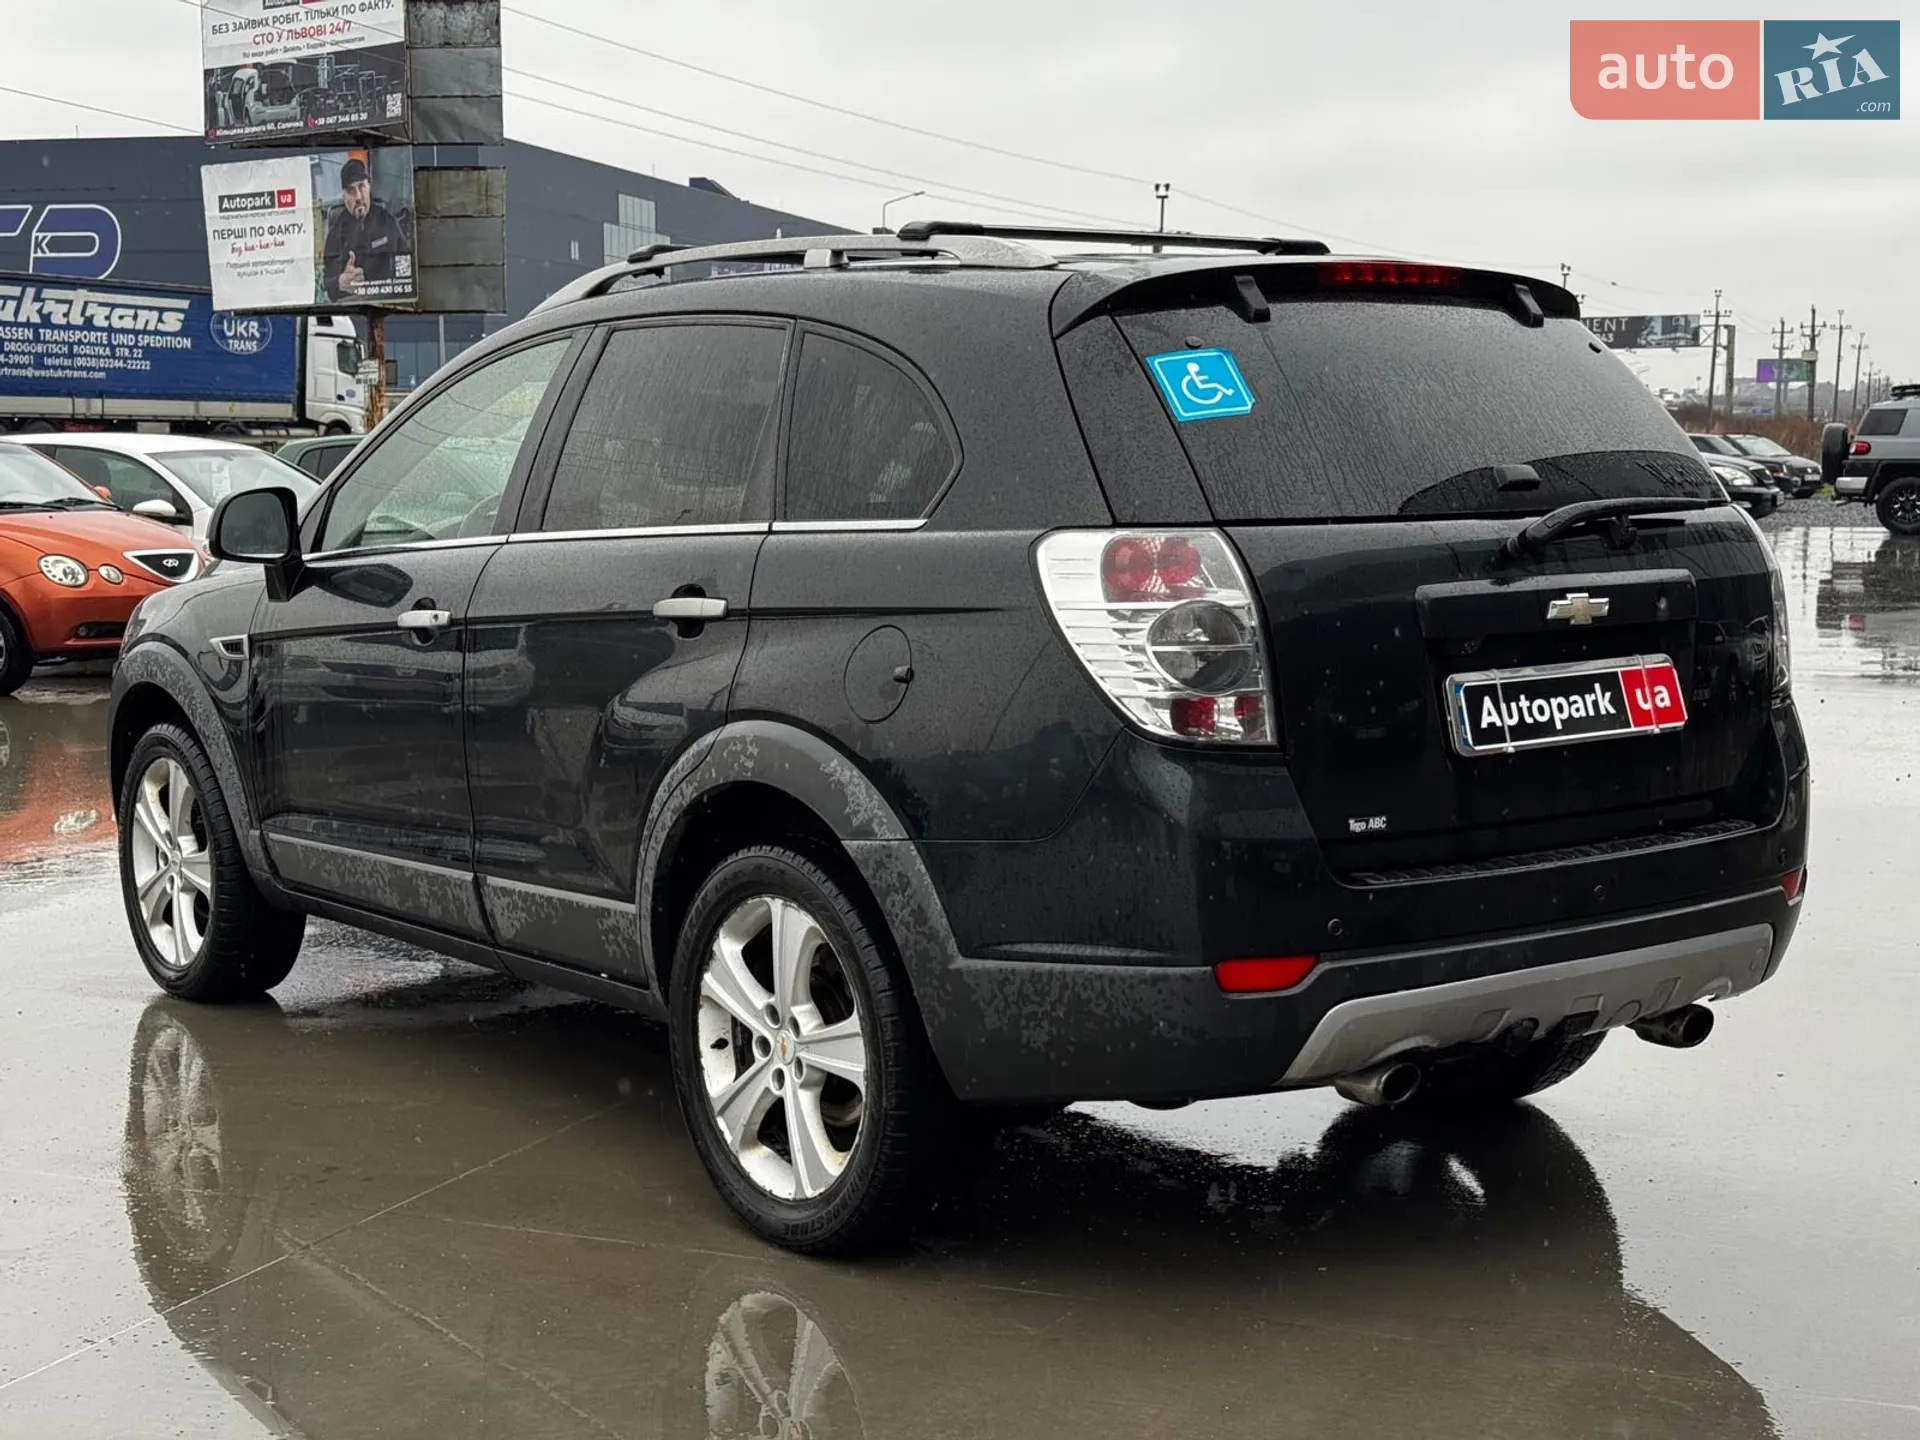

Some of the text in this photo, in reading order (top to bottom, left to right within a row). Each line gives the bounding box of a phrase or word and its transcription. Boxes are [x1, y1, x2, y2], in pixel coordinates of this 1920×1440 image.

[212, 0, 394, 35] БЕЗ ЗАЙВИХ РОБІТ. ТІЛЬКИ ПО ФАКТУ.
[253, 20, 352, 45] СТО У ЛЬВОВІ 24/7
[222, 193, 292, 209] Autopark ua
[213, 222, 306, 241] ПЕРШІ ПО ФАКТУ.
[223, 319, 261, 338] UKR
[4, 341, 69, 354] DROGOBYTSCH
[38, 328, 108, 344] TRANSPORTE
[111, 333, 136, 346] UND
[138, 334, 191, 349] SPEDITION
[228, 339, 257, 352] TRANS
[1480, 683, 1671, 730] Autopark ua
[1367, 816, 1387, 829] ABC
